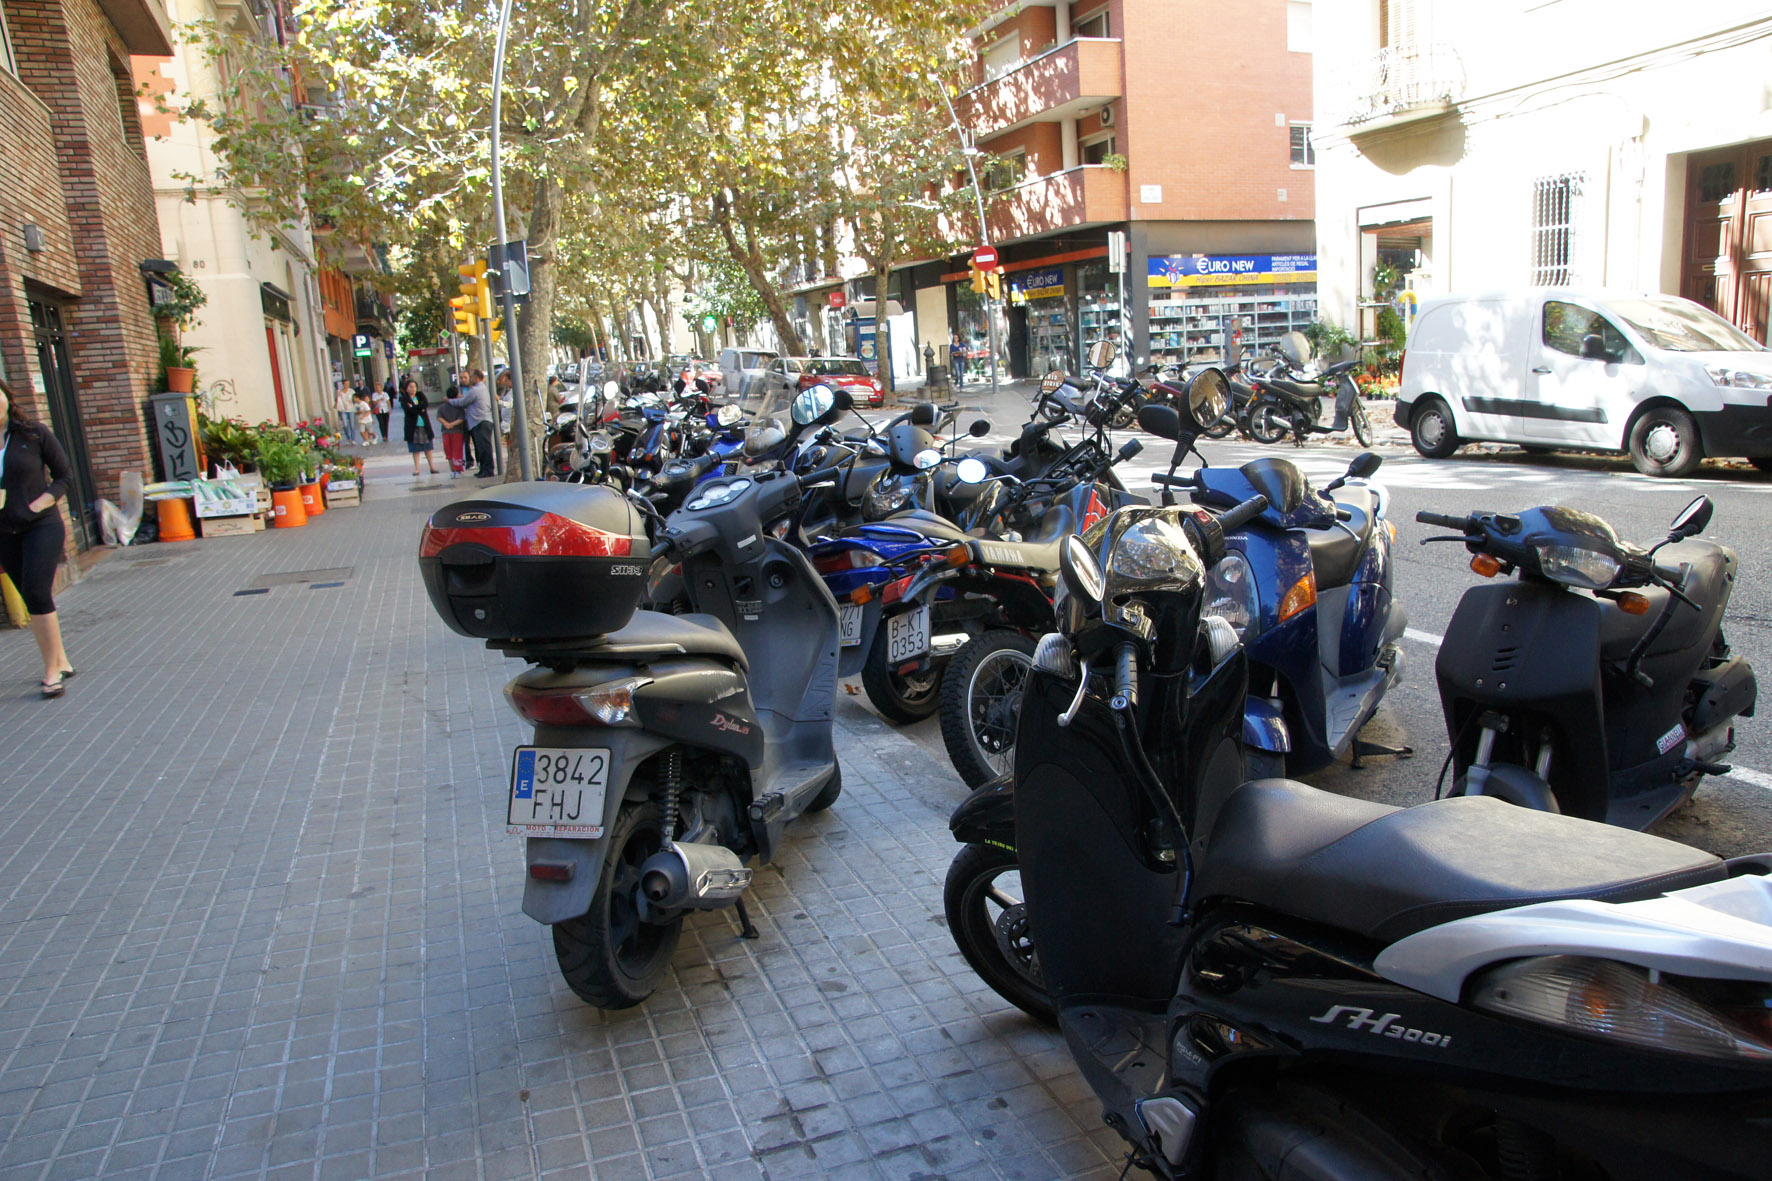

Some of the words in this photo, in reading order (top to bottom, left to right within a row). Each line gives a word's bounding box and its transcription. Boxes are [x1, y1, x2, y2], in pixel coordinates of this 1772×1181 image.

[193, 260, 205, 268] 80
[1232, 260, 1254, 271] NEW
[1045, 274, 1057, 285] NEW
[355, 335, 367, 348] P
[982, 545, 1024, 563] YAMAHA
[892, 610, 923, 639] B-KT
[892, 631, 924, 659] 0353
[537, 754, 604, 785] 3842
[521, 780, 529, 790] E
[532, 789, 582, 820] FHJ
